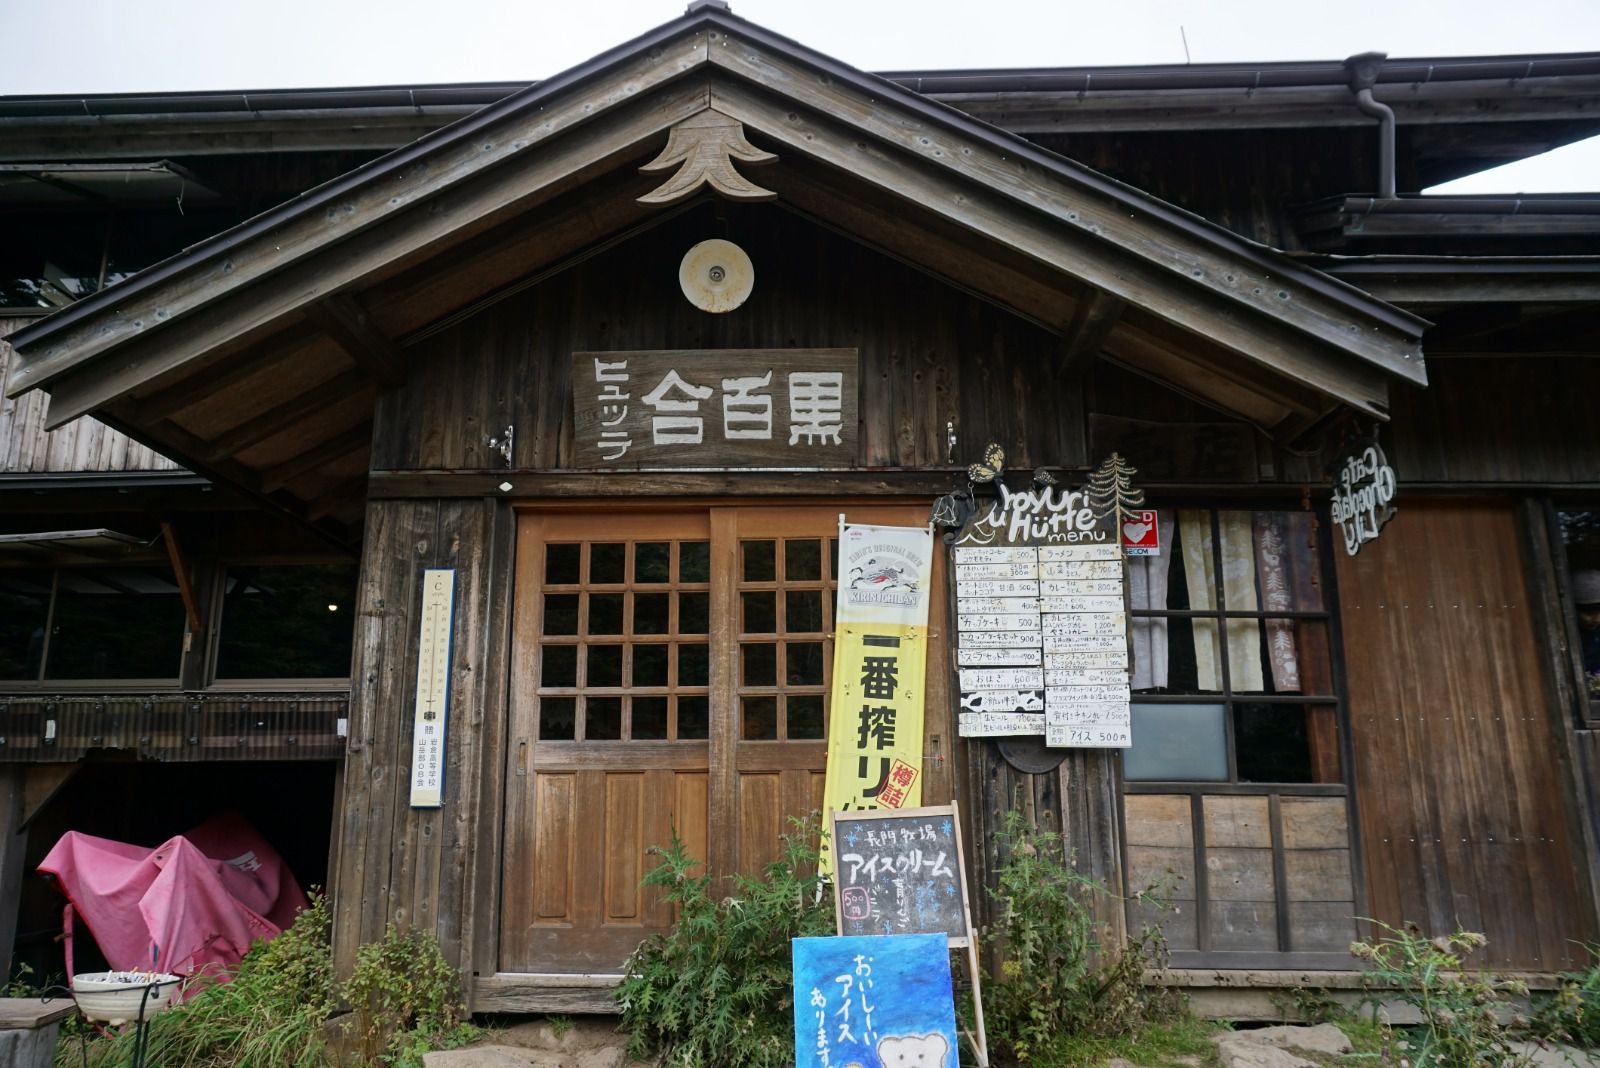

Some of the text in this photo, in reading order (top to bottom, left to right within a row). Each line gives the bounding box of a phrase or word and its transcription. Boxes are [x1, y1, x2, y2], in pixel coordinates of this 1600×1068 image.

[1008, 508, 1097, 543] Hütte
[1048, 530, 1106, 543] menu
[848, 635, 901, 808] 一番搾り
[1070, 730, 1092, 741] アイス
[841, 849, 953, 885] アイスクリーム
[835, 974, 858, 1044] アイス
